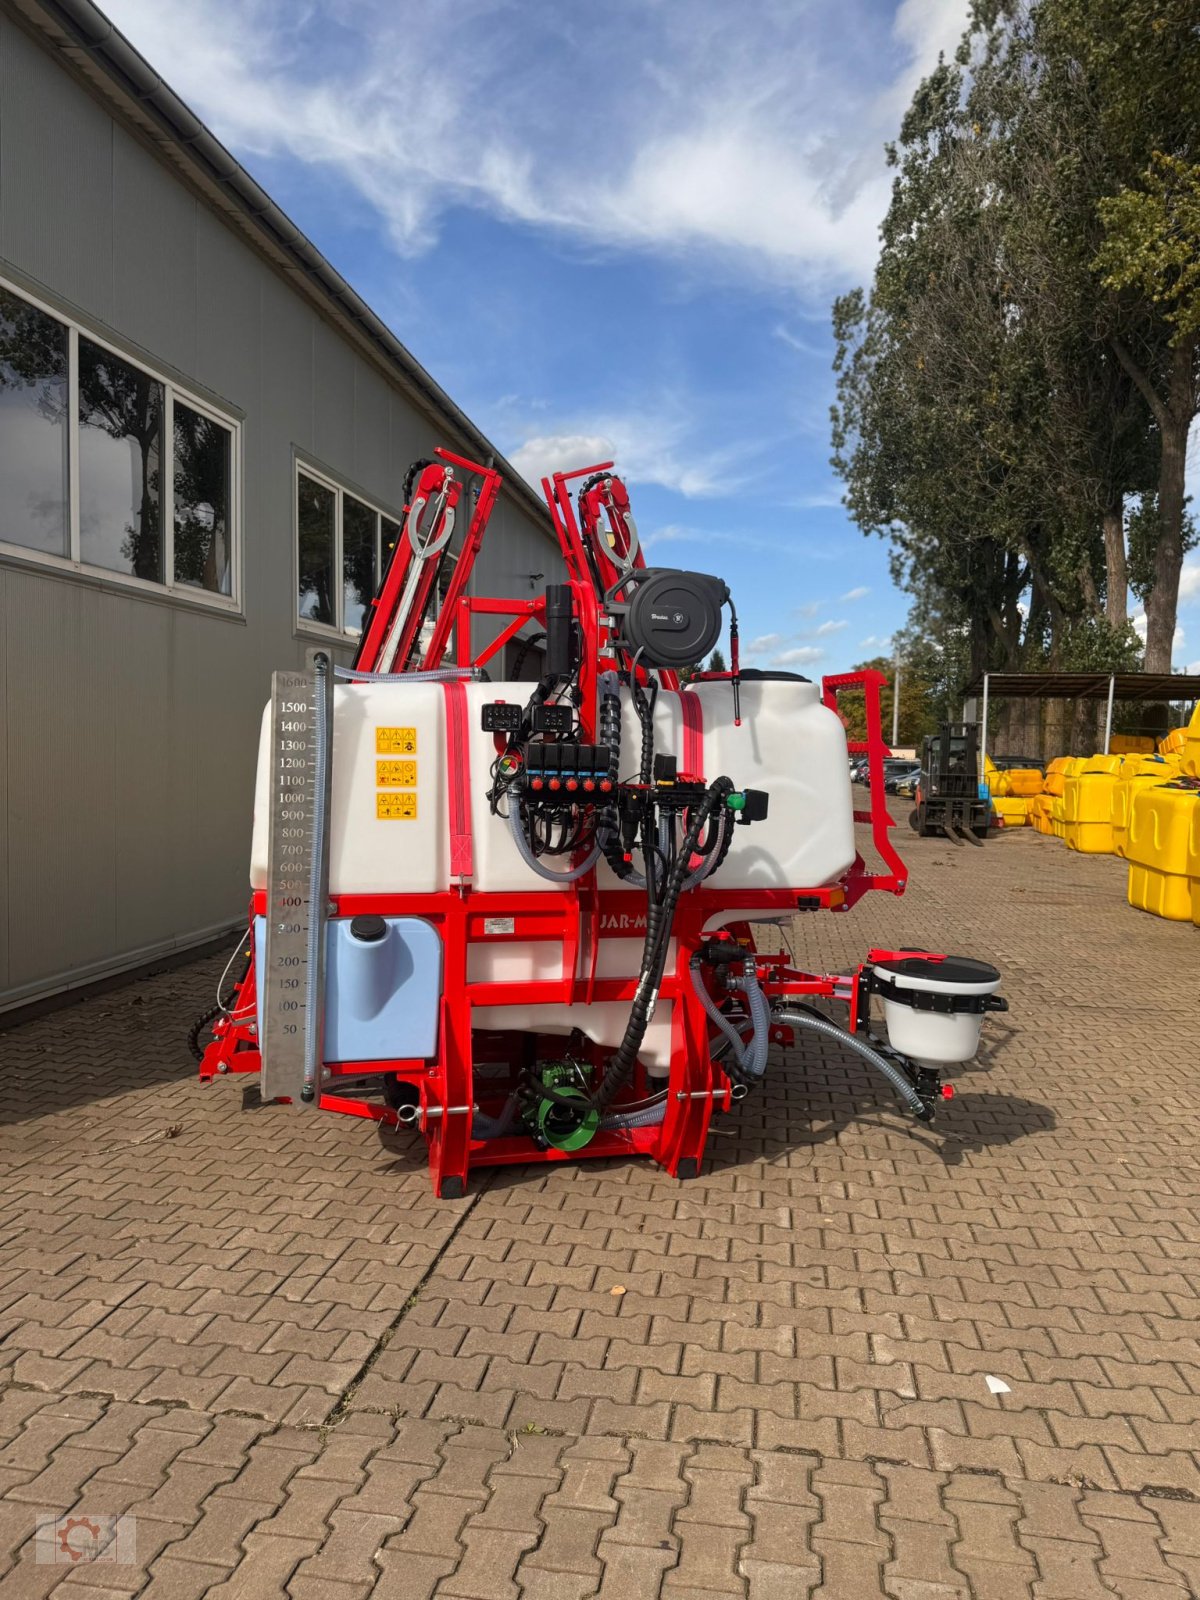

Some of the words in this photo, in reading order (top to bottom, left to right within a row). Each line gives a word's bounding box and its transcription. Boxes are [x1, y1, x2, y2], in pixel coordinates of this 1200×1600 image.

[282, 678, 307, 687] 1600
[282, 702, 306, 712] 1500
[281, 722, 306, 732] 1400
[280, 740, 306, 750] 1300
[280, 758, 306, 768] 1200
[280, 776, 305, 786] 1100
[280, 793, 304, 802] 1000
[282, 810, 304, 820] 900
[282, 828, 304, 838] 800
[282, 845, 303, 855] 700
[280, 863, 302, 872] 600
[280, 880, 302, 890] 500
[279, 897, 302, 906] 400
[278, 924, 300, 934] 300
[278, 957, 300, 966] 200
[280, 979, 298, 988] 150
[279, 1002, 298, 1010] 100
[282, 1024, 296, 1034] 50
